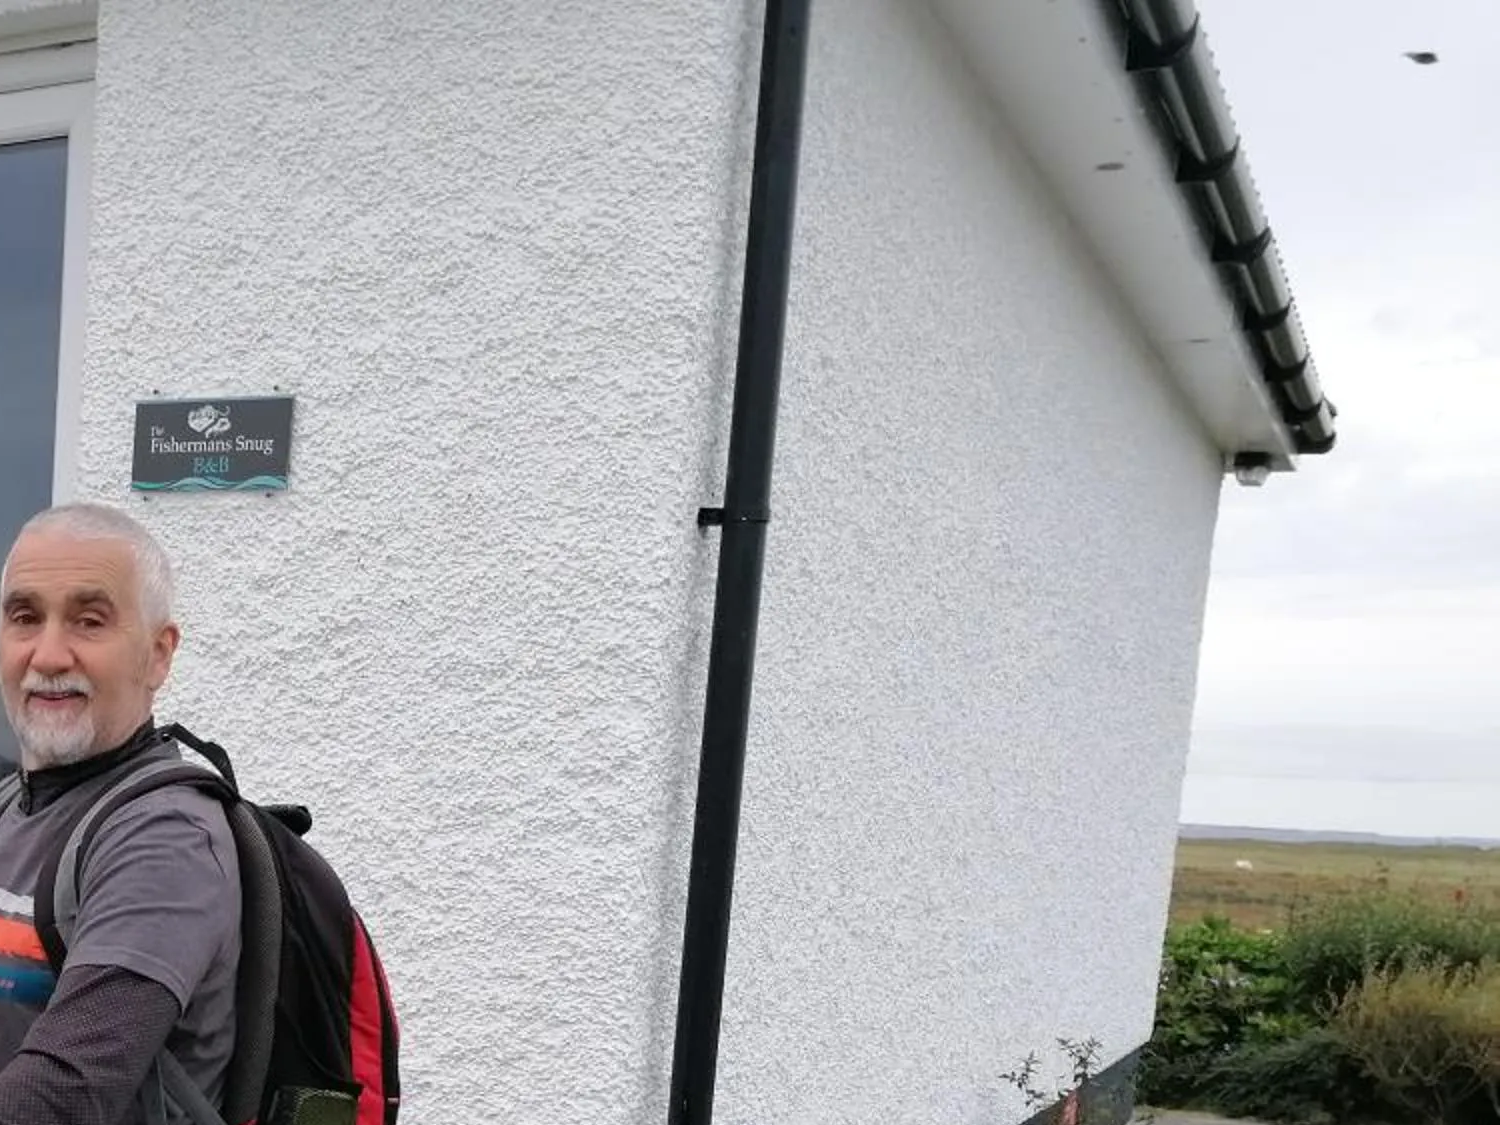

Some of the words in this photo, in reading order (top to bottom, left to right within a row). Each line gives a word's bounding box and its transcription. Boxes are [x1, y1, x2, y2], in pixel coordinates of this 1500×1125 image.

[151, 435, 233, 454] Fishermans
[235, 434, 274, 456] Snug
[193, 456, 229, 474] B&B
